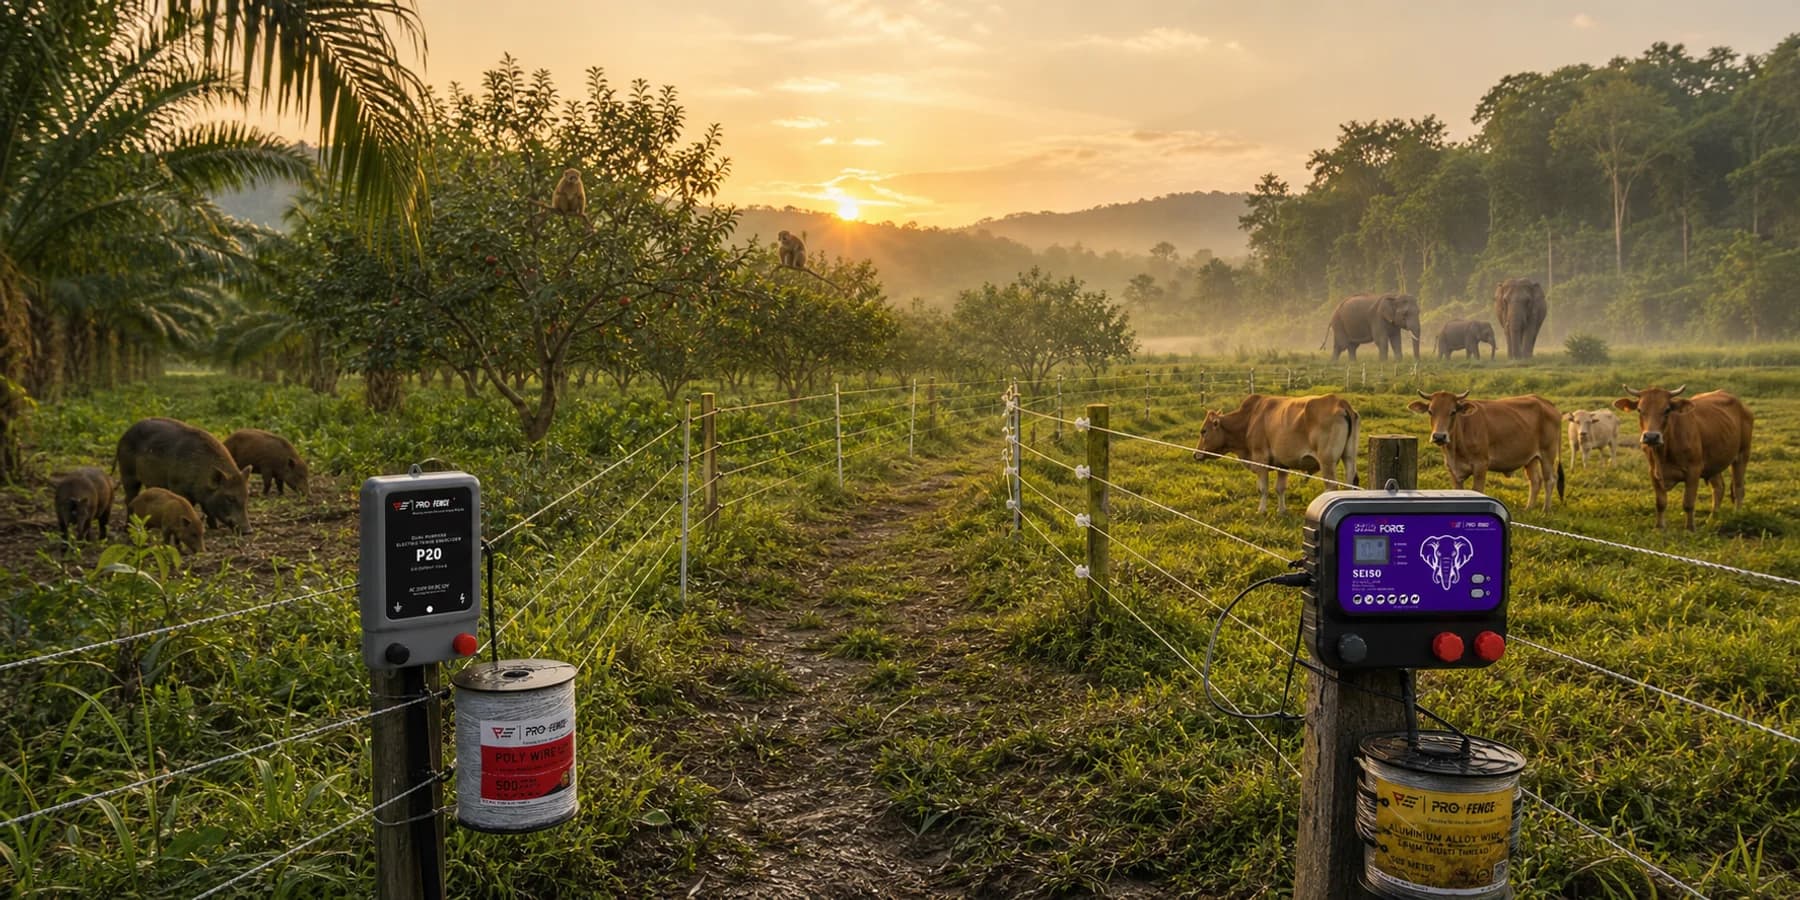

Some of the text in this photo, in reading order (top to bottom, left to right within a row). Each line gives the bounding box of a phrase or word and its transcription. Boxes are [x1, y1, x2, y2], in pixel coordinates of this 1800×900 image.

[415, 501, 430, 509] PRO
[1379, 524, 1406, 533] FORCE
[416, 547, 442, 562] P20
[525, 725, 546, 737] PRO
[495, 752, 526, 764] POLY
[530, 746, 557, 761] WIRE
[1431, 800, 1460, 814] PRO
[1466, 801, 1496, 815] FENCE
[1445, 834, 1477, 844] ALLOY
